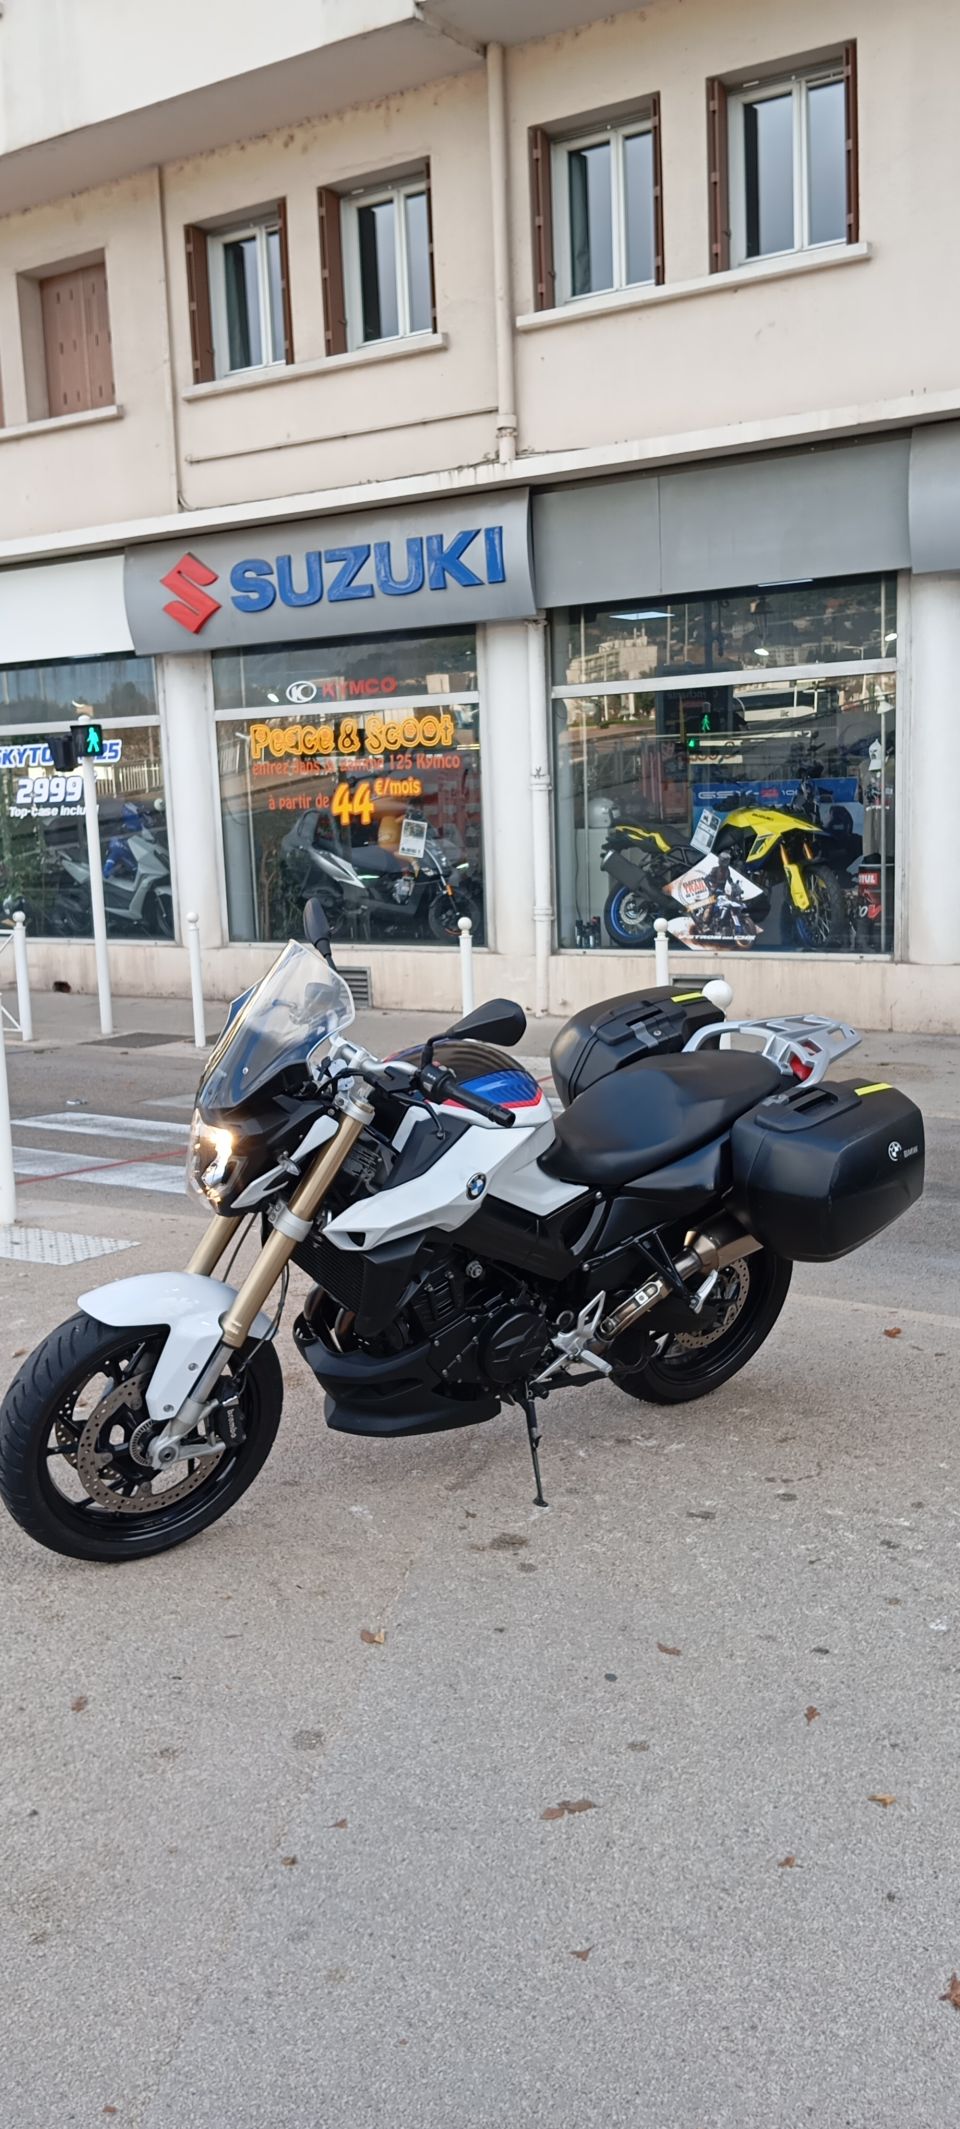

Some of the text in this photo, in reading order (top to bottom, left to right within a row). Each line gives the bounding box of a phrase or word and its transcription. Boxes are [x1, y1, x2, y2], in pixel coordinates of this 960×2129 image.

[229, 525, 506, 613] SUZUKI
[322, 676, 397, 698] KYMCO
[251, 714, 454, 759] Peace & Scoot
[252, 760, 289, 776] entrez
[389, 753, 413, 771] 125
[416, 753, 461, 771] Kymco
[279, 795, 312, 811] partir
[315, 792, 330, 808] de
[331, 782, 374, 826] 44
[374, 776, 422, 797] €/mois
[226, 1408, 237, 1438] brembo
